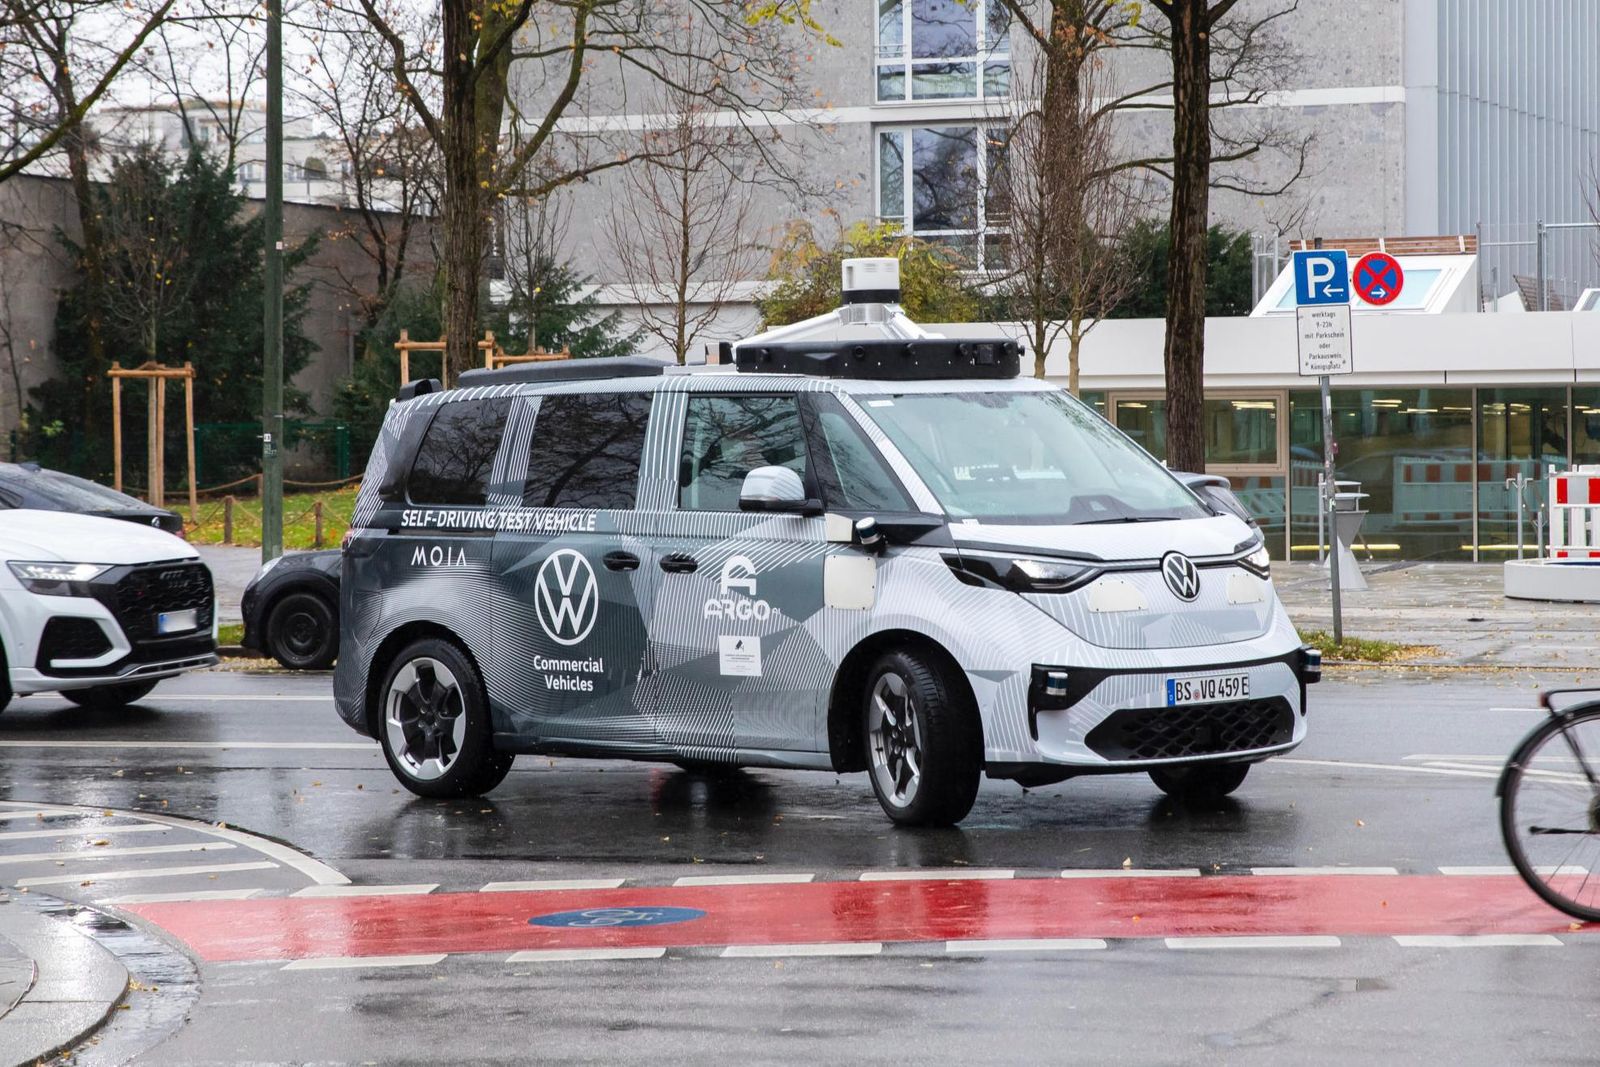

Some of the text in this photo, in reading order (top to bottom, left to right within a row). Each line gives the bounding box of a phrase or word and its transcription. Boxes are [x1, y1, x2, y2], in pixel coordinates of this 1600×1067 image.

[1306, 257, 1335, 298] P
[1312, 311, 1336, 319] werktags
[1315, 331, 1345, 339] Parkschein
[400, 509, 597, 532] SELF-DRIVING TEST VEHICLE
[411, 546, 467, 566] MOIA
[704, 599, 771, 621] ARGO
[533, 655, 604, 673] Commercial
[544, 674, 594, 692] Vehicles
[1175, 681, 1192, 701] BS
